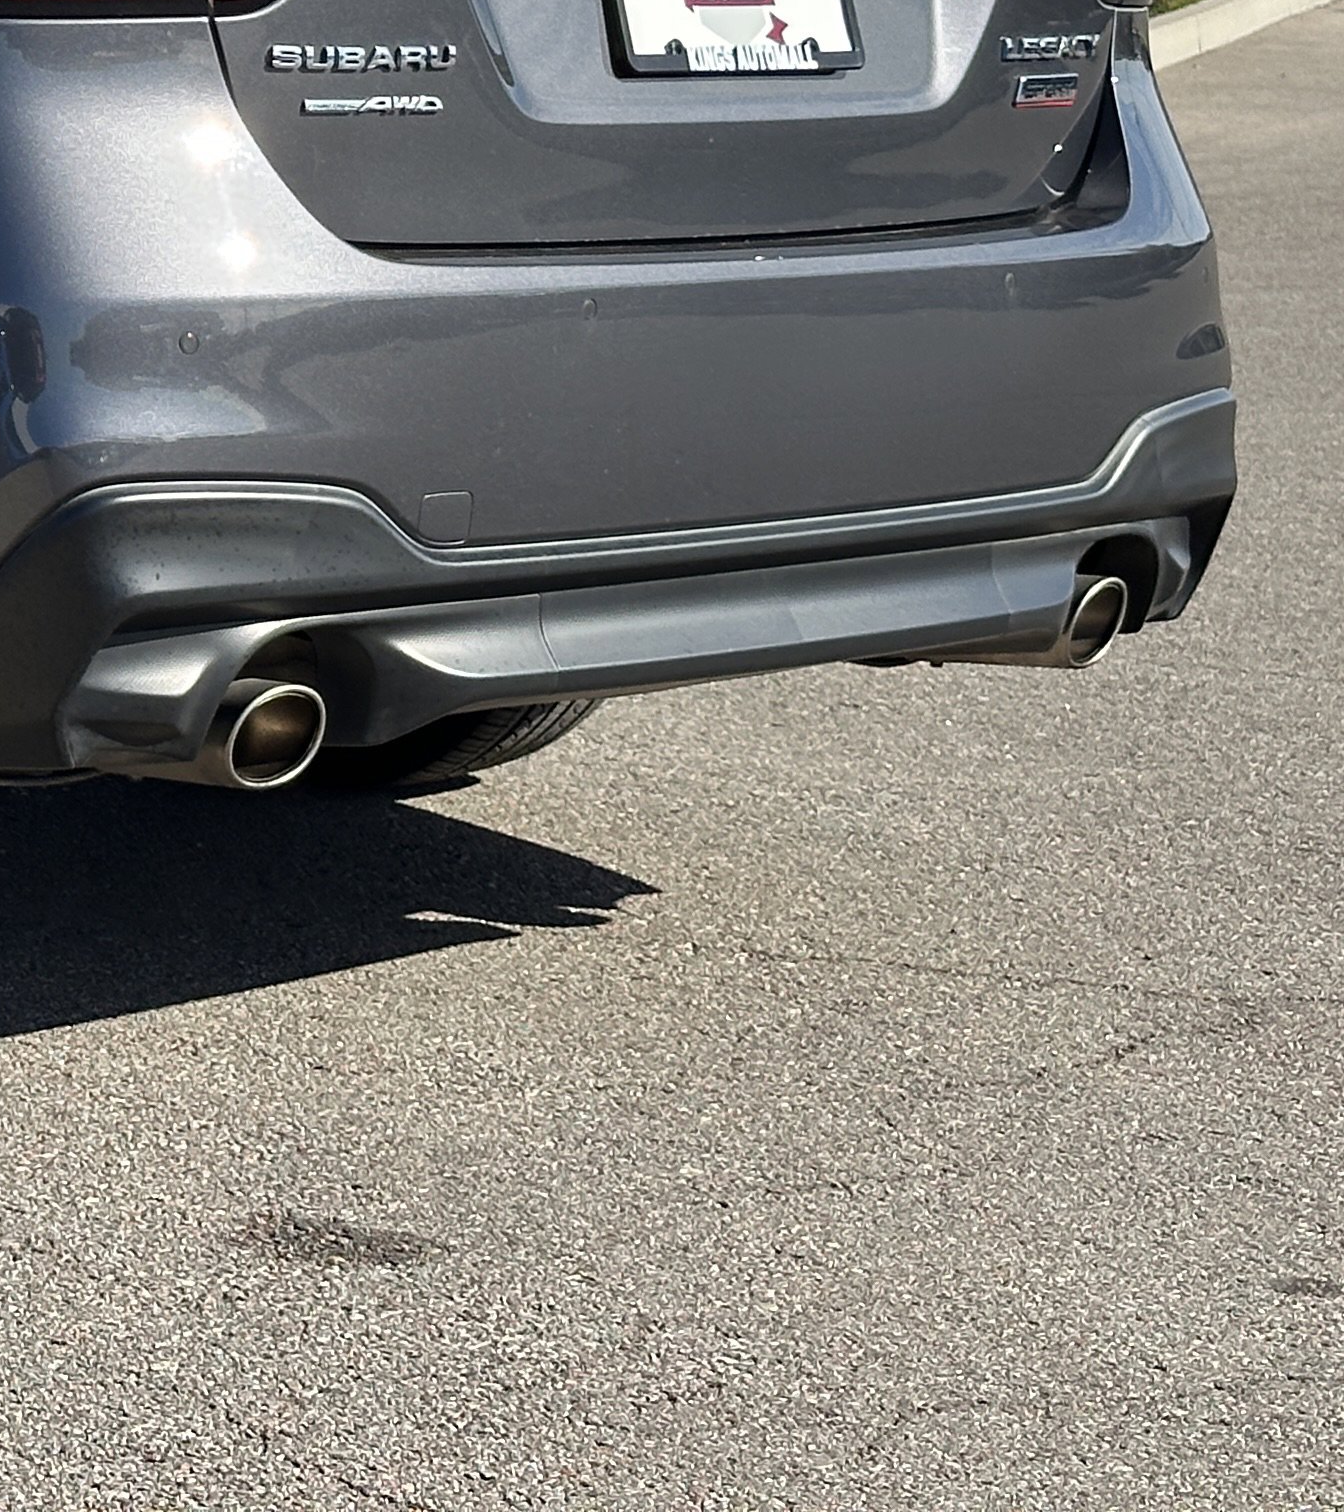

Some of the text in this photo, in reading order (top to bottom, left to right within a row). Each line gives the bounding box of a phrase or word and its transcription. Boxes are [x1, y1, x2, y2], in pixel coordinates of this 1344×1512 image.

[265, 44, 458, 72] SUBARU
[687, 42, 819, 71] KINGS AUTOMALL
[999, 35, 1101, 61] LEGACY
[358, 95, 444, 115] AWD
